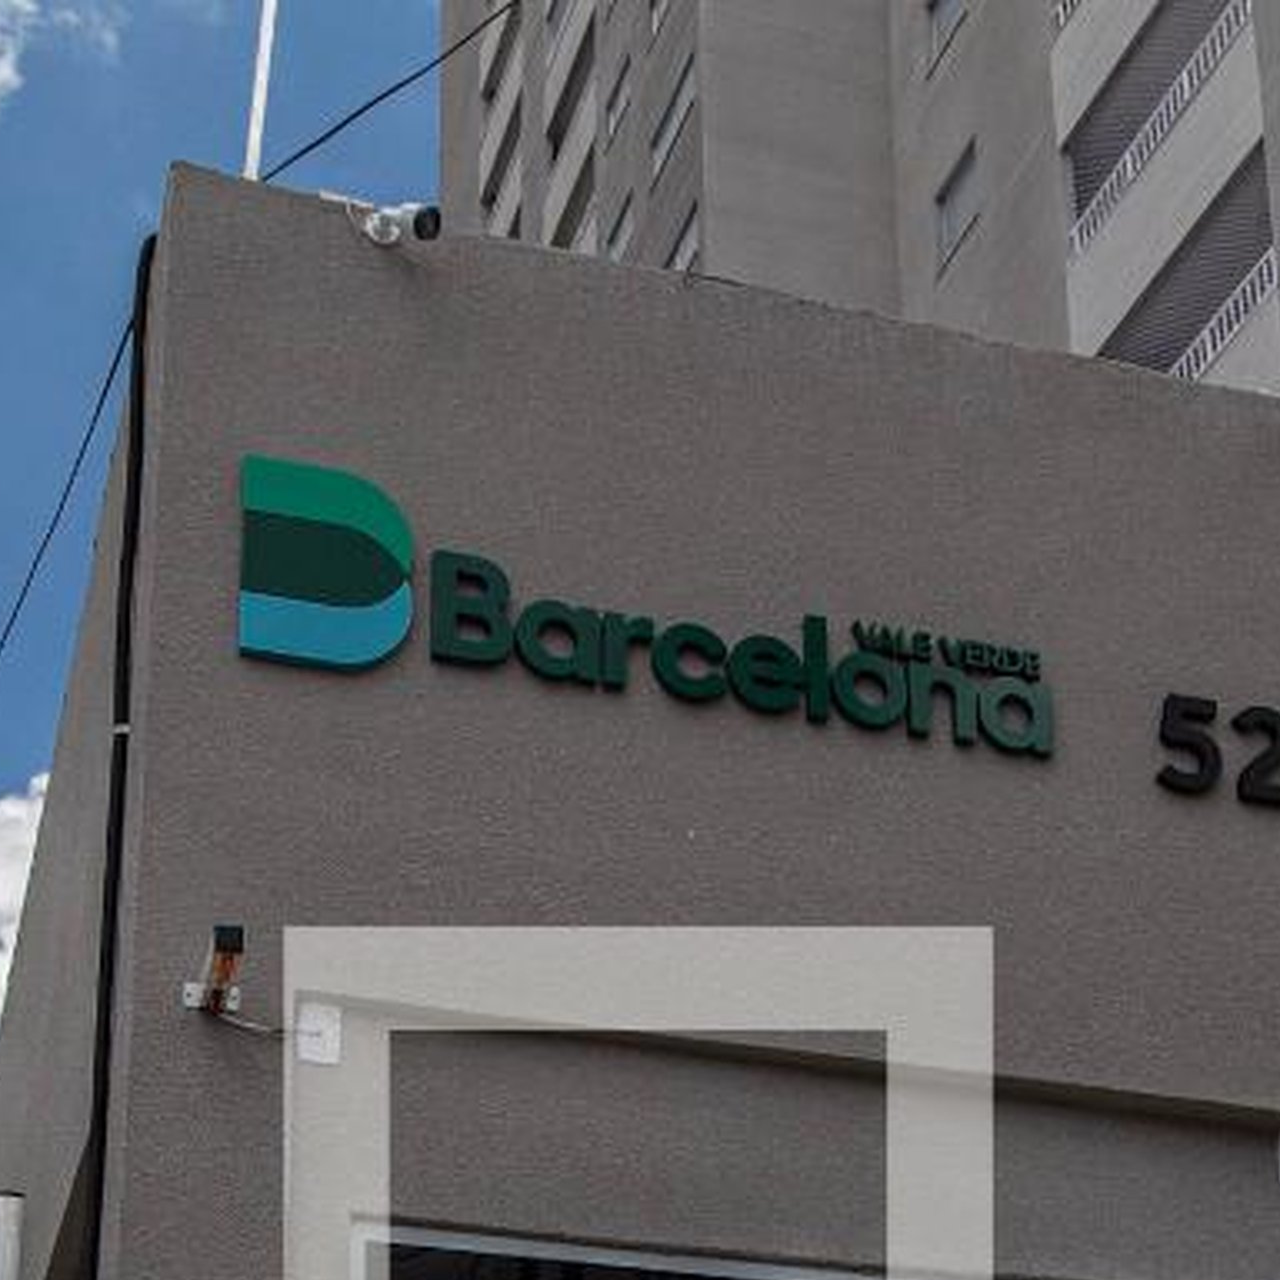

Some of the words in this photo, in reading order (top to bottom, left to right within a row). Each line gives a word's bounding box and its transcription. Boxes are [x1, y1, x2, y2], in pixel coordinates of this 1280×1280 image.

[429, 548, 1055, 758] Barcelona
[851, 619, 932, 662] VALE
[937, 635, 1042, 683] VERDE
